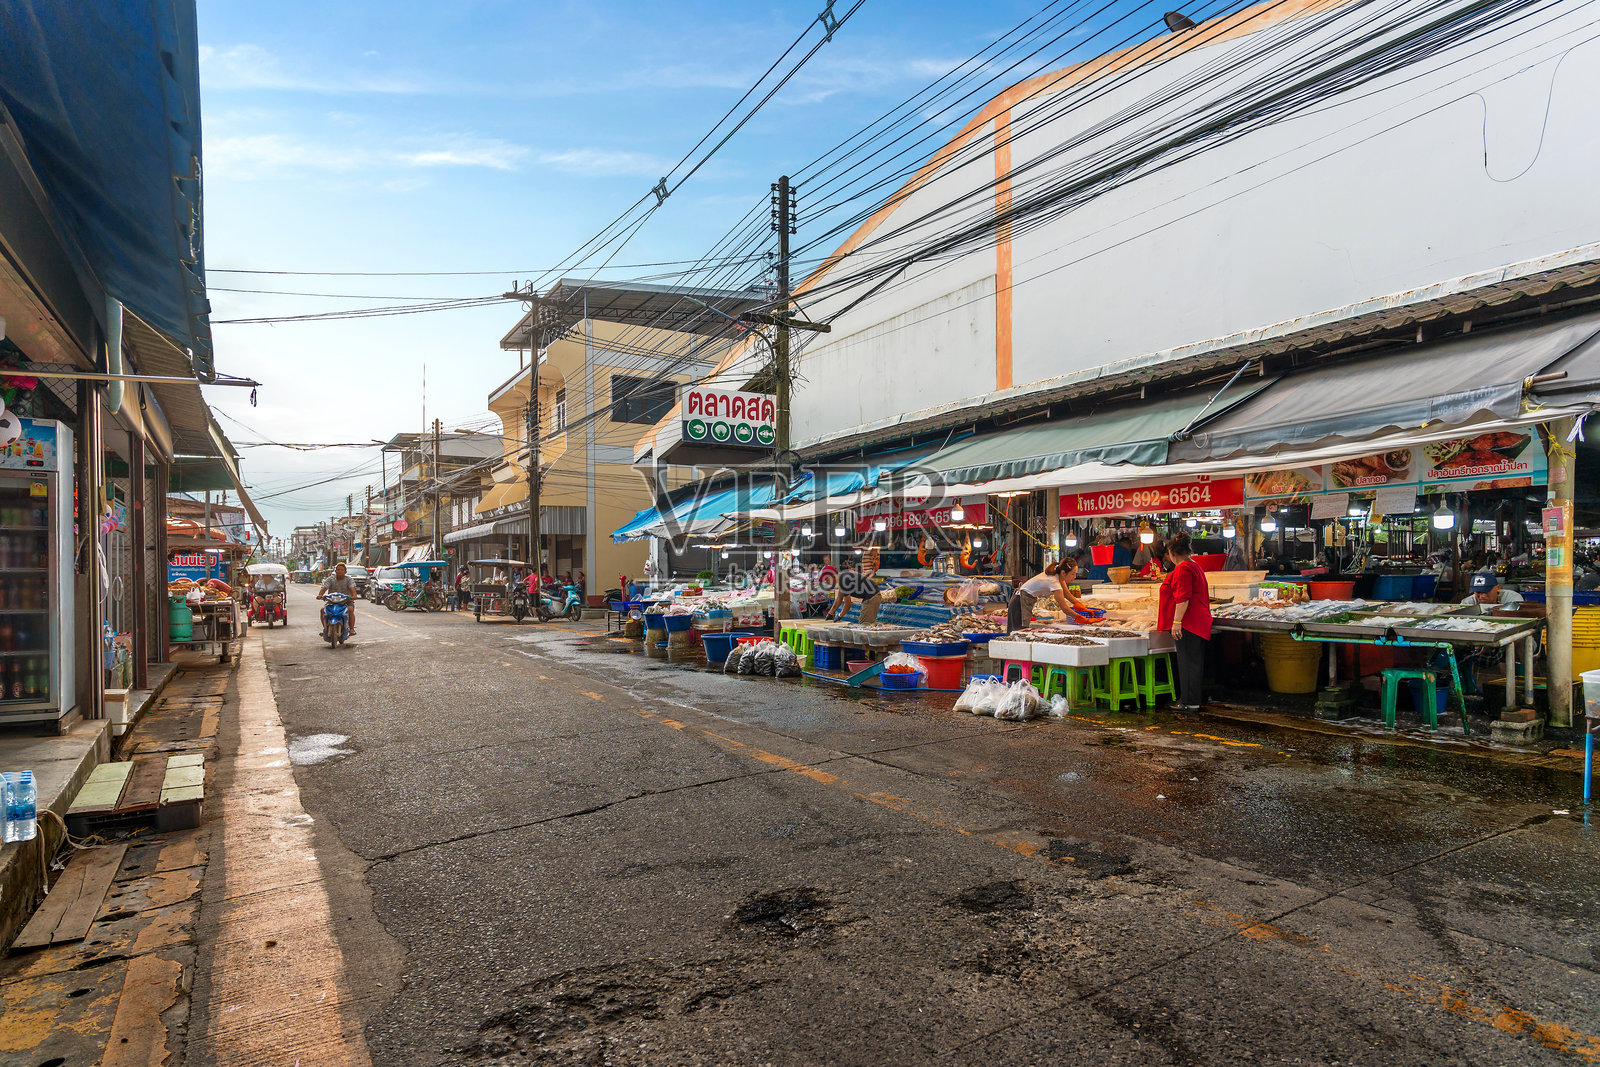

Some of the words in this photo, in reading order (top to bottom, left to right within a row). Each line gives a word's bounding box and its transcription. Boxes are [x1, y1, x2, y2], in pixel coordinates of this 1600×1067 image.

[688, 391, 775, 422] ตลาดสด
[1427, 459, 1528, 478] ปลาอินทรีทอดราดน้ำปลา
[1355, 474, 1388, 486] ปลาทอด
[1079, 486, 1211, 512] โทร.096-892-6564
